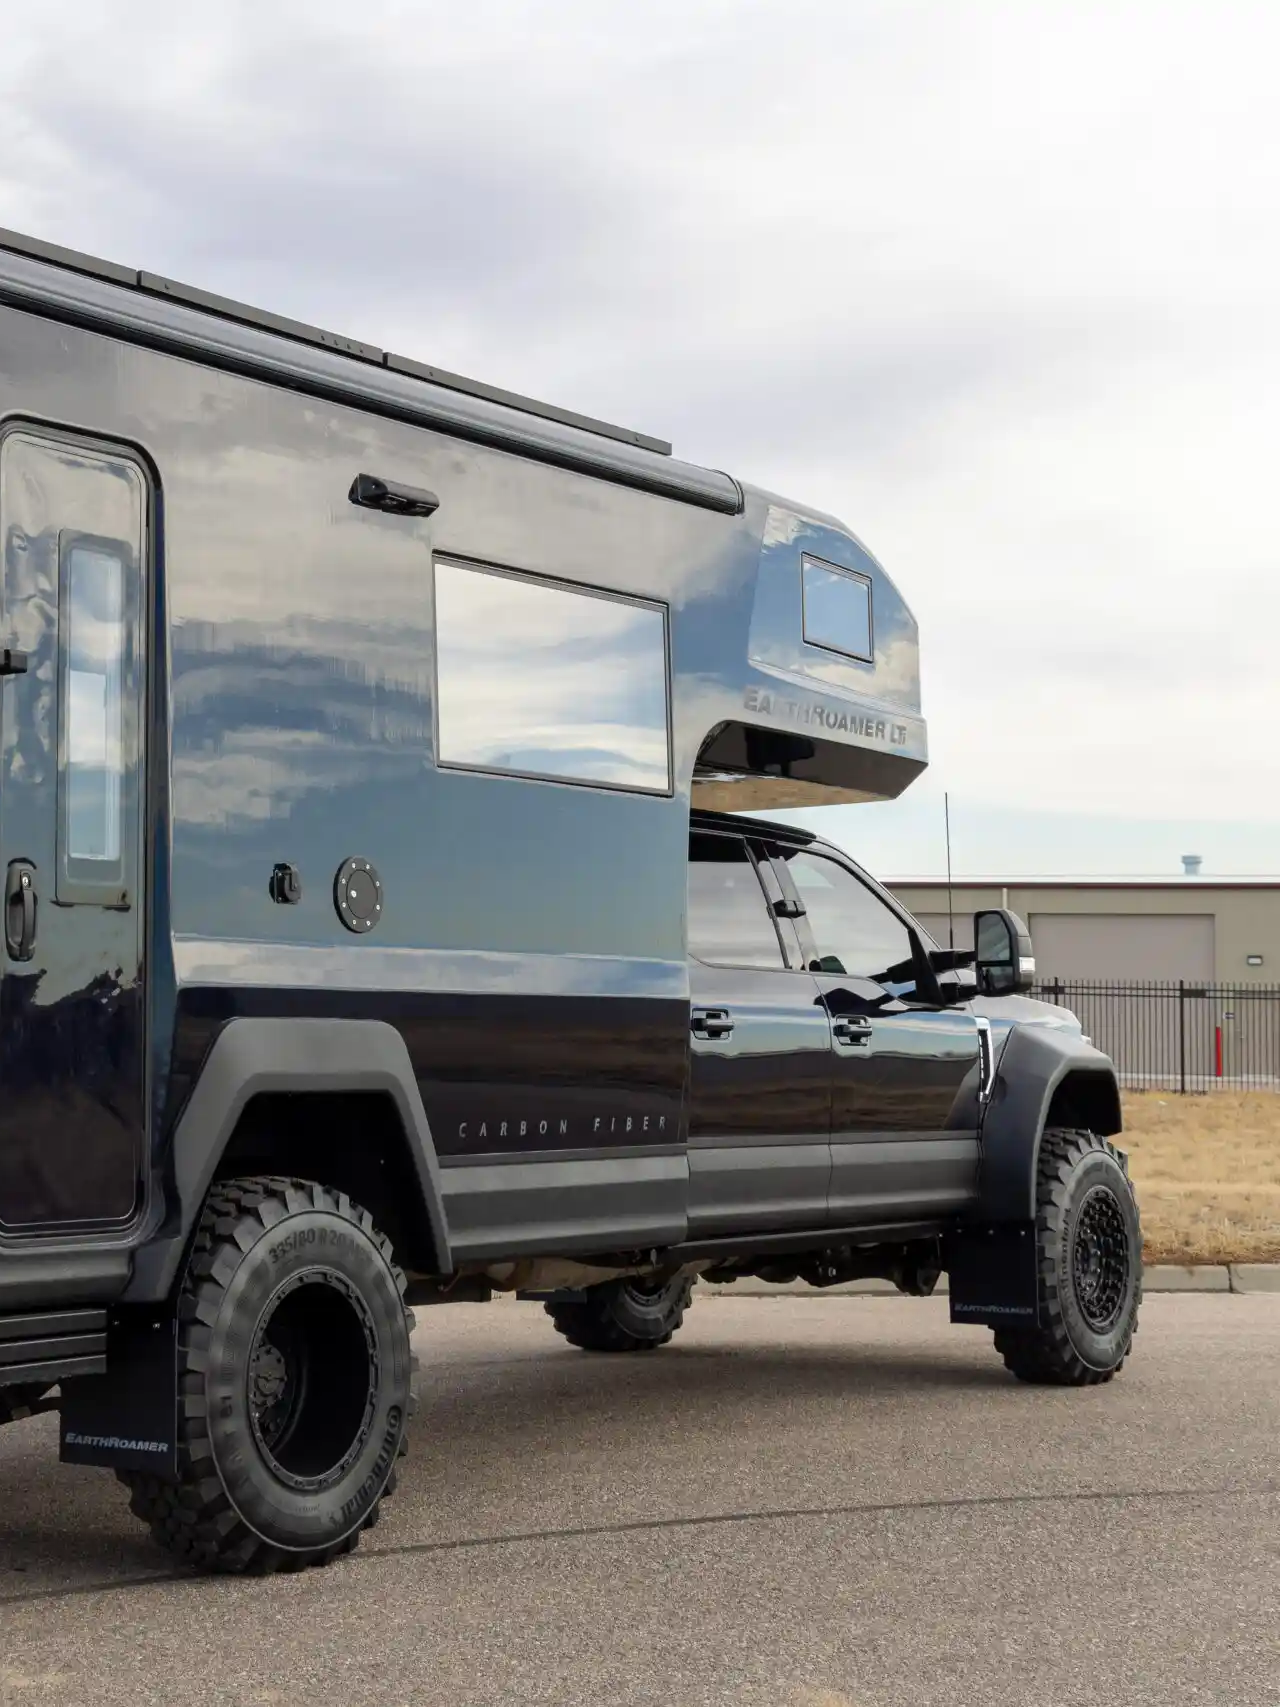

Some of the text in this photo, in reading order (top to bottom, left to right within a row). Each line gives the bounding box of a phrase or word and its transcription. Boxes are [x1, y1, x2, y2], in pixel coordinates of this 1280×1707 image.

[742, 684, 887, 740] EATHROAMER
[458, 1115, 667, 1138] CARBON FIBER
[64, 1432, 169, 1452] EARTHROAMER
